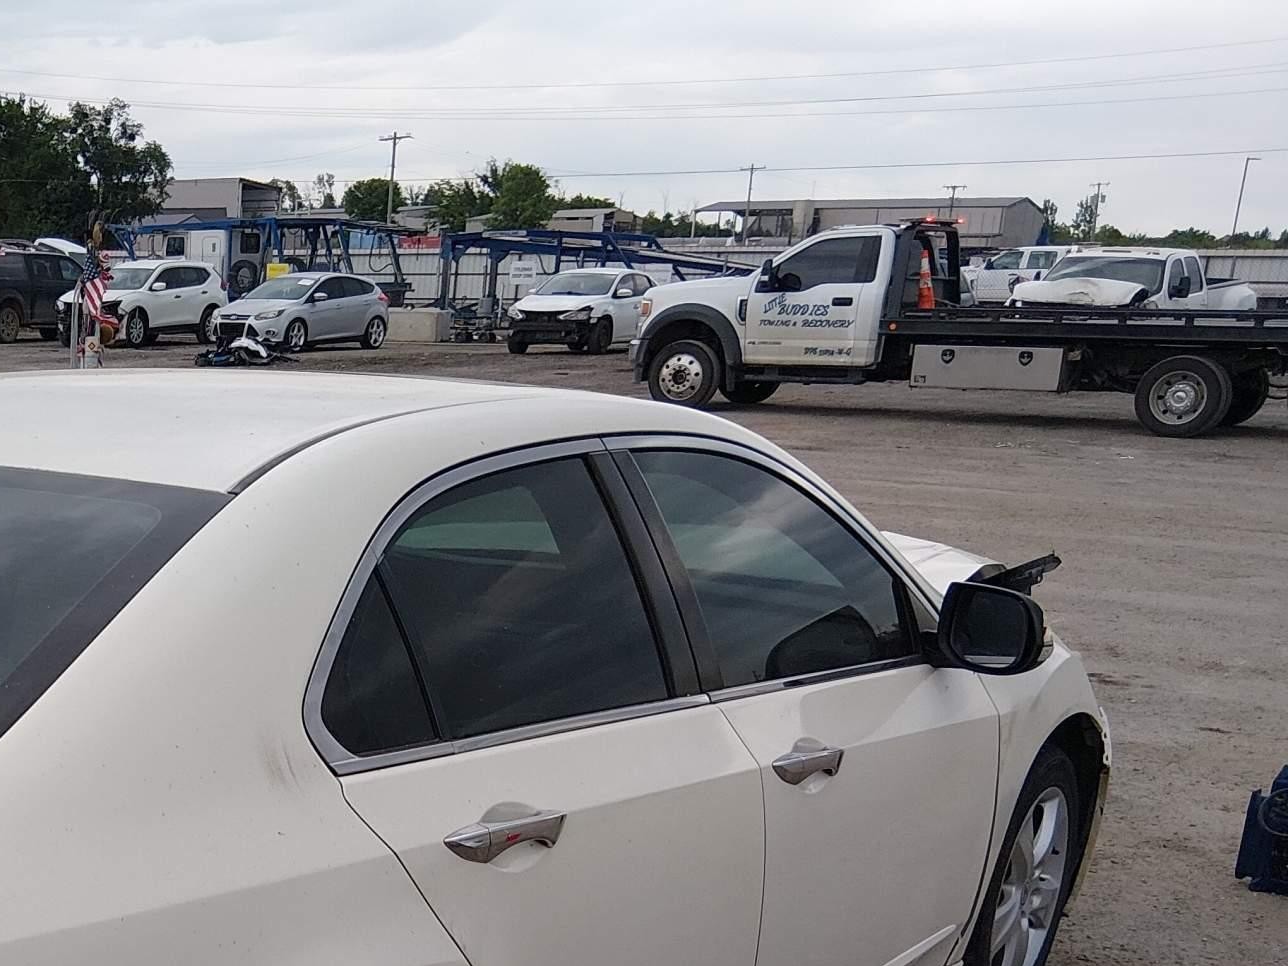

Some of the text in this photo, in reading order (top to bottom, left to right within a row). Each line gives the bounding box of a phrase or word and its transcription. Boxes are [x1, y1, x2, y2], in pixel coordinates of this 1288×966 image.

[777, 304, 829, 316] BUDDIES
[759, 319, 791, 327] TOWING
[801, 319, 854, 328] RECOVERY
